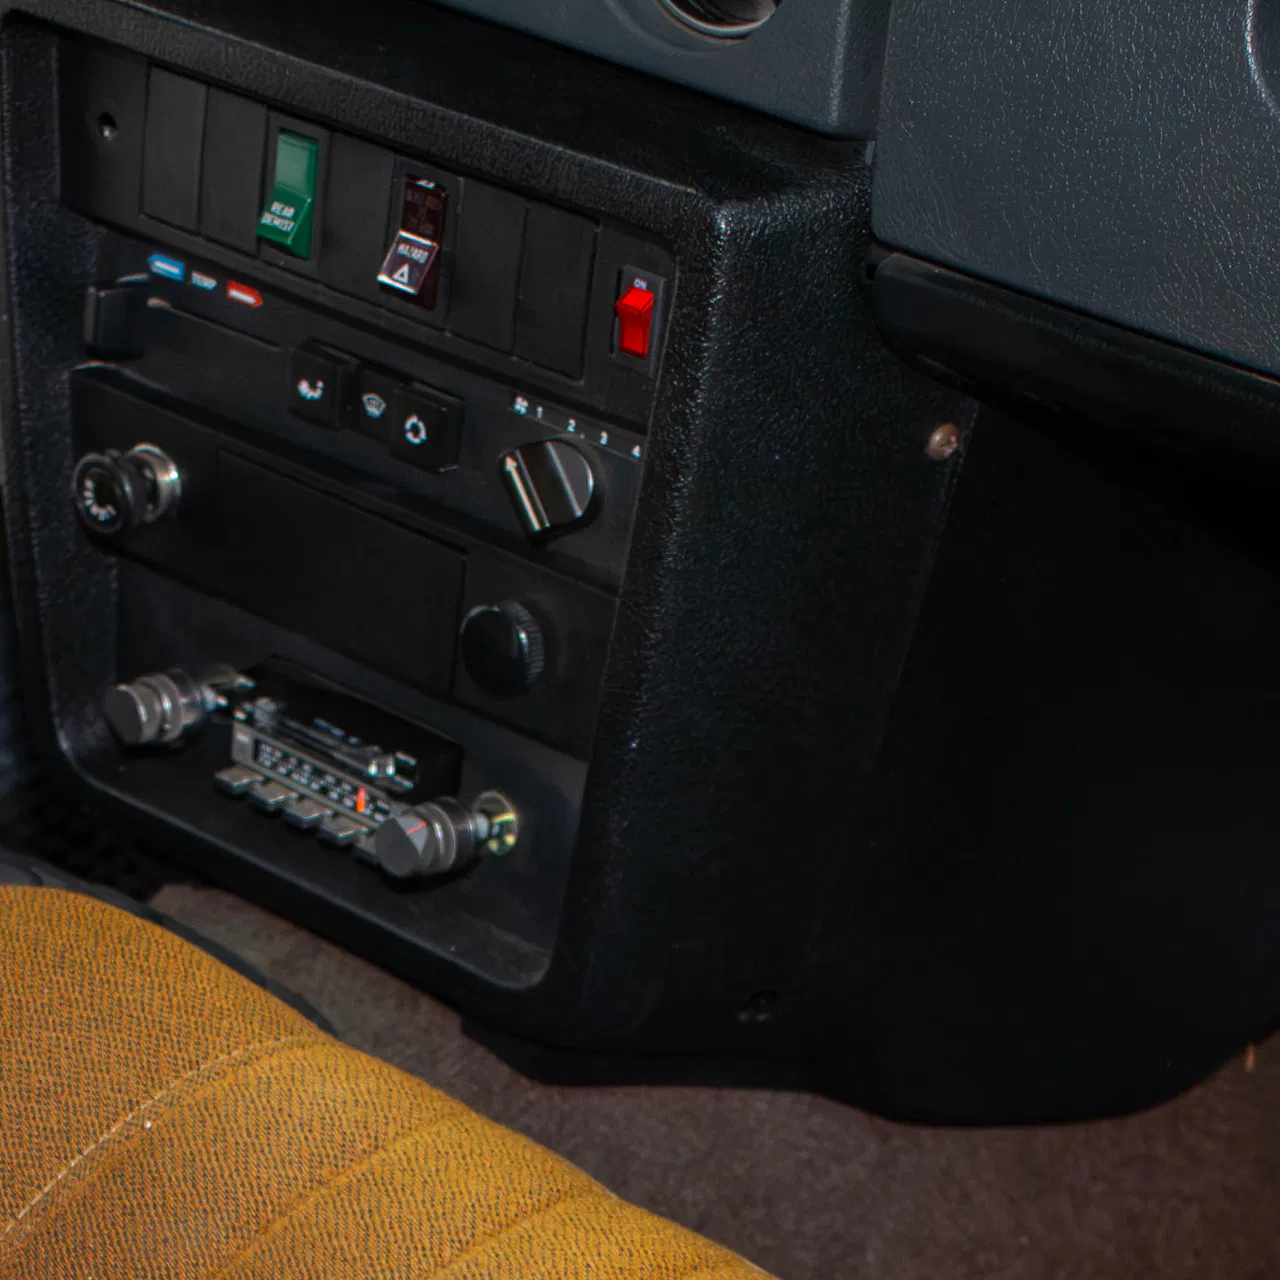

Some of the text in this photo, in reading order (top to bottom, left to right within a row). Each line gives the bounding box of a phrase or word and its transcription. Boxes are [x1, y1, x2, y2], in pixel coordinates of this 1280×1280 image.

[633, 277, 648, 290] ON
[536, 405, 641, 459] 1 2 3 4
